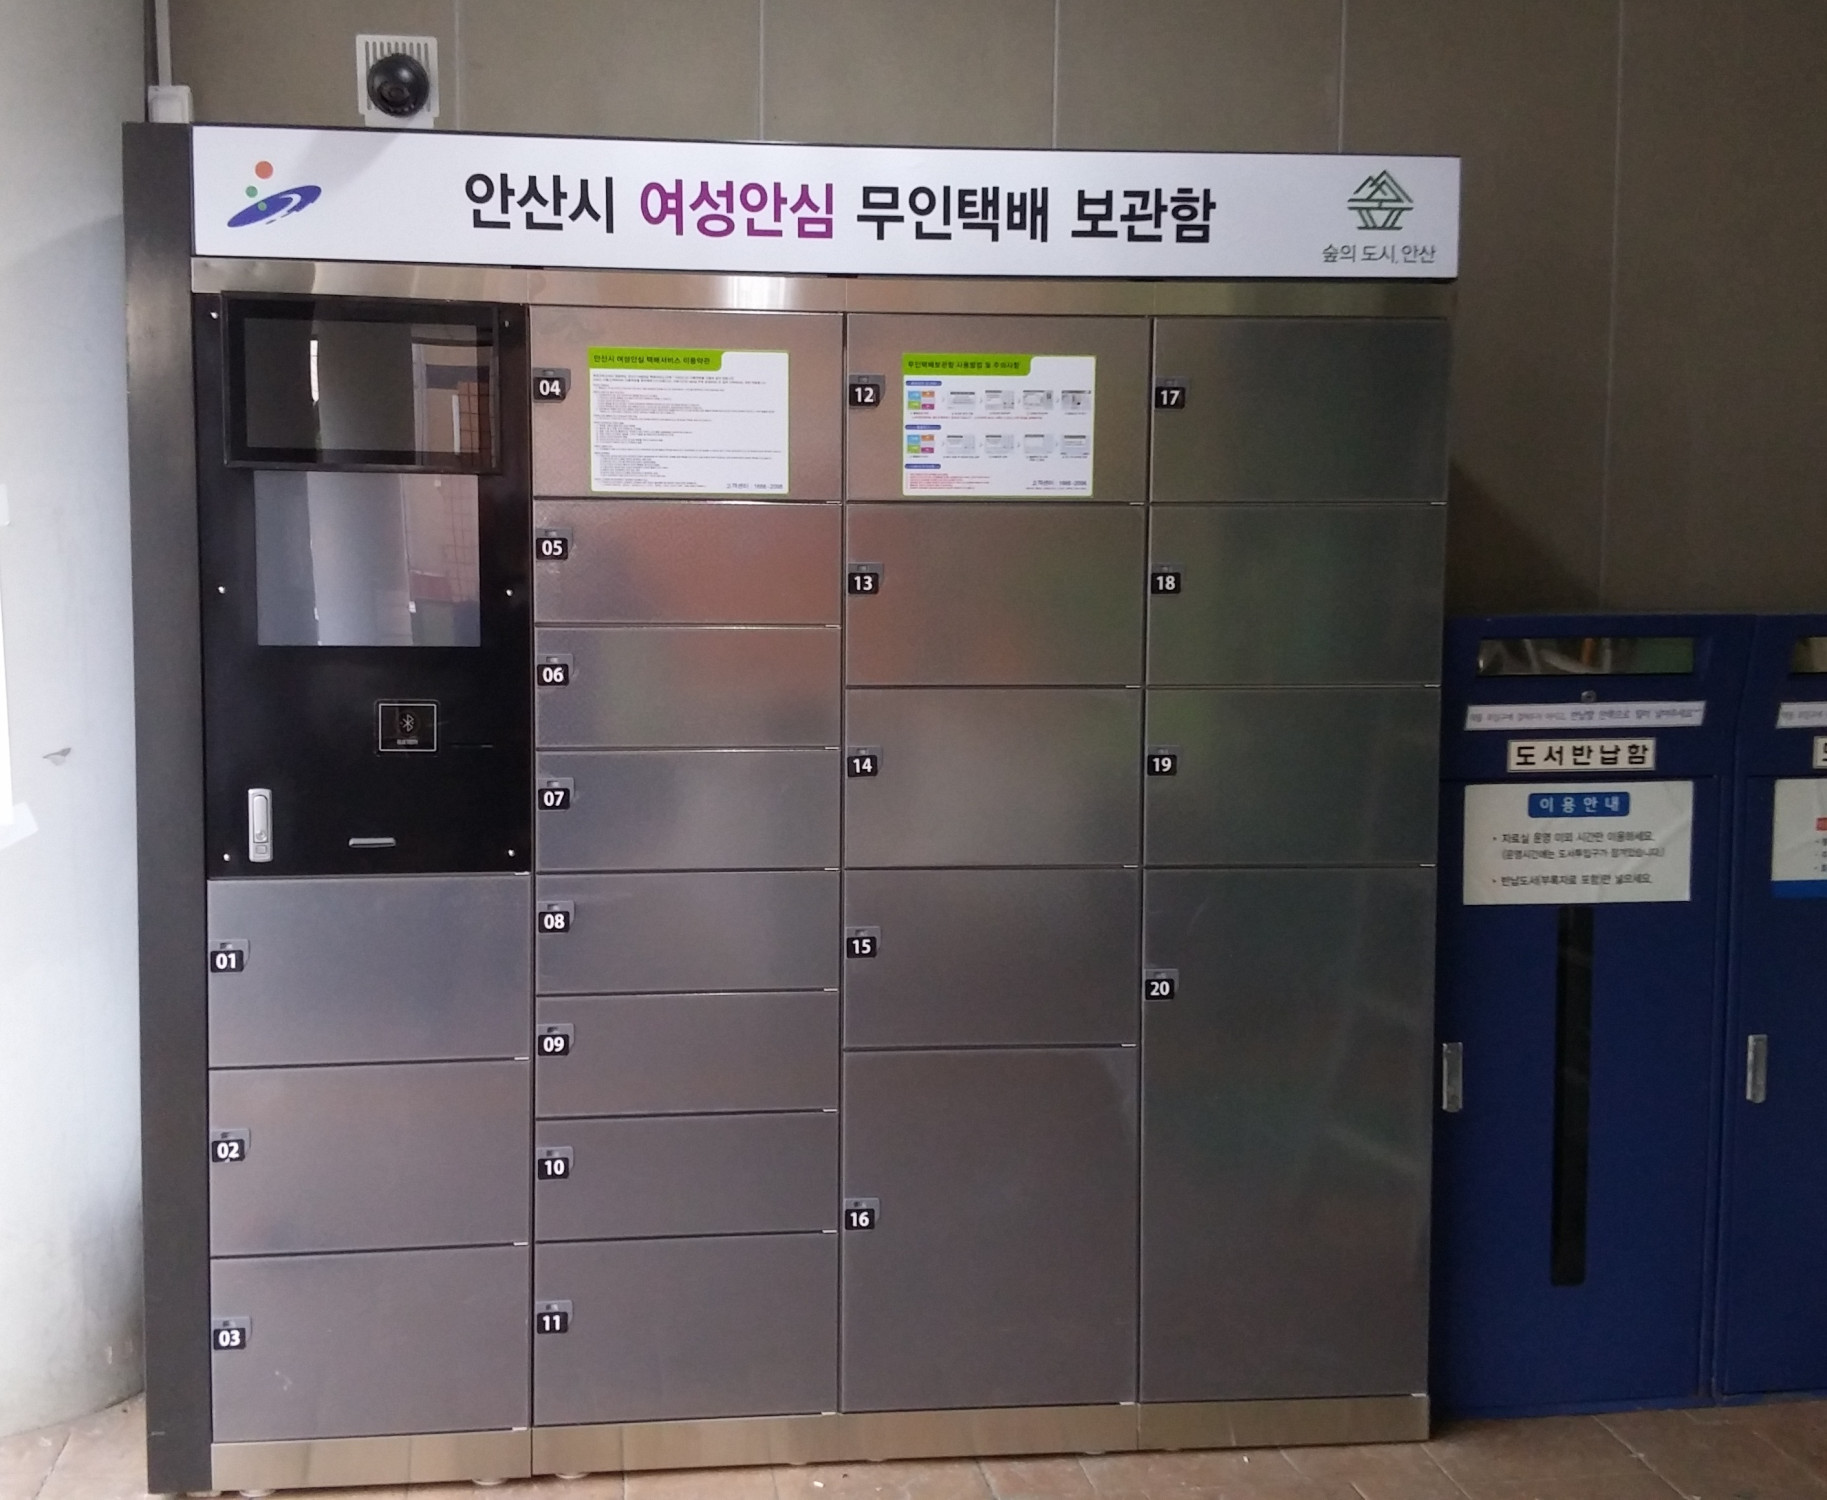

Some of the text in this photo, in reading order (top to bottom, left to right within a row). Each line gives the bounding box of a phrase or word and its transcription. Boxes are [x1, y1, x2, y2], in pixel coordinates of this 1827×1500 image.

[466, 173, 1216, 243] 안산시 여성안심 무인택배 보관함
[1322, 243, 1357, 263] 숲의
[1401, 244, 1437, 264] 안산
[540, 381, 561, 395] 04
[855, 387, 874, 402] 12
[1161, 390, 1180, 404] 17
[542, 541, 562, 555] 05
[854, 576, 872, 591] 13
[1157, 576, 1175, 590] 18
[543, 668, 564, 682] 06
[1516, 744, 1649, 766] 도서반납함
[853, 759, 872, 773] 14
[1153, 758, 1171, 772] 19
[544, 792, 564, 806] 07
[1540, 796, 1620, 813] 이용안내
[1501, 832, 1529, 843] 자료실
[1533, 832, 1551, 843] 운영
[1554, 832, 1573, 842] 이외
[1577, 831, 1604, 842] 시간만
[544, 914, 565, 929] 08
[852, 940, 871, 954] 15
[216, 954, 236, 968] 01
[1150, 981, 1170, 996] 20
[544, 1037, 564, 1052] 09
[217, 1144, 239, 1159] 02
[544, 1160, 564, 1175] 10
[850, 1212, 869, 1227] 16
[543, 1316, 561, 1330] 11
[219, 1331, 240, 1346] 03
